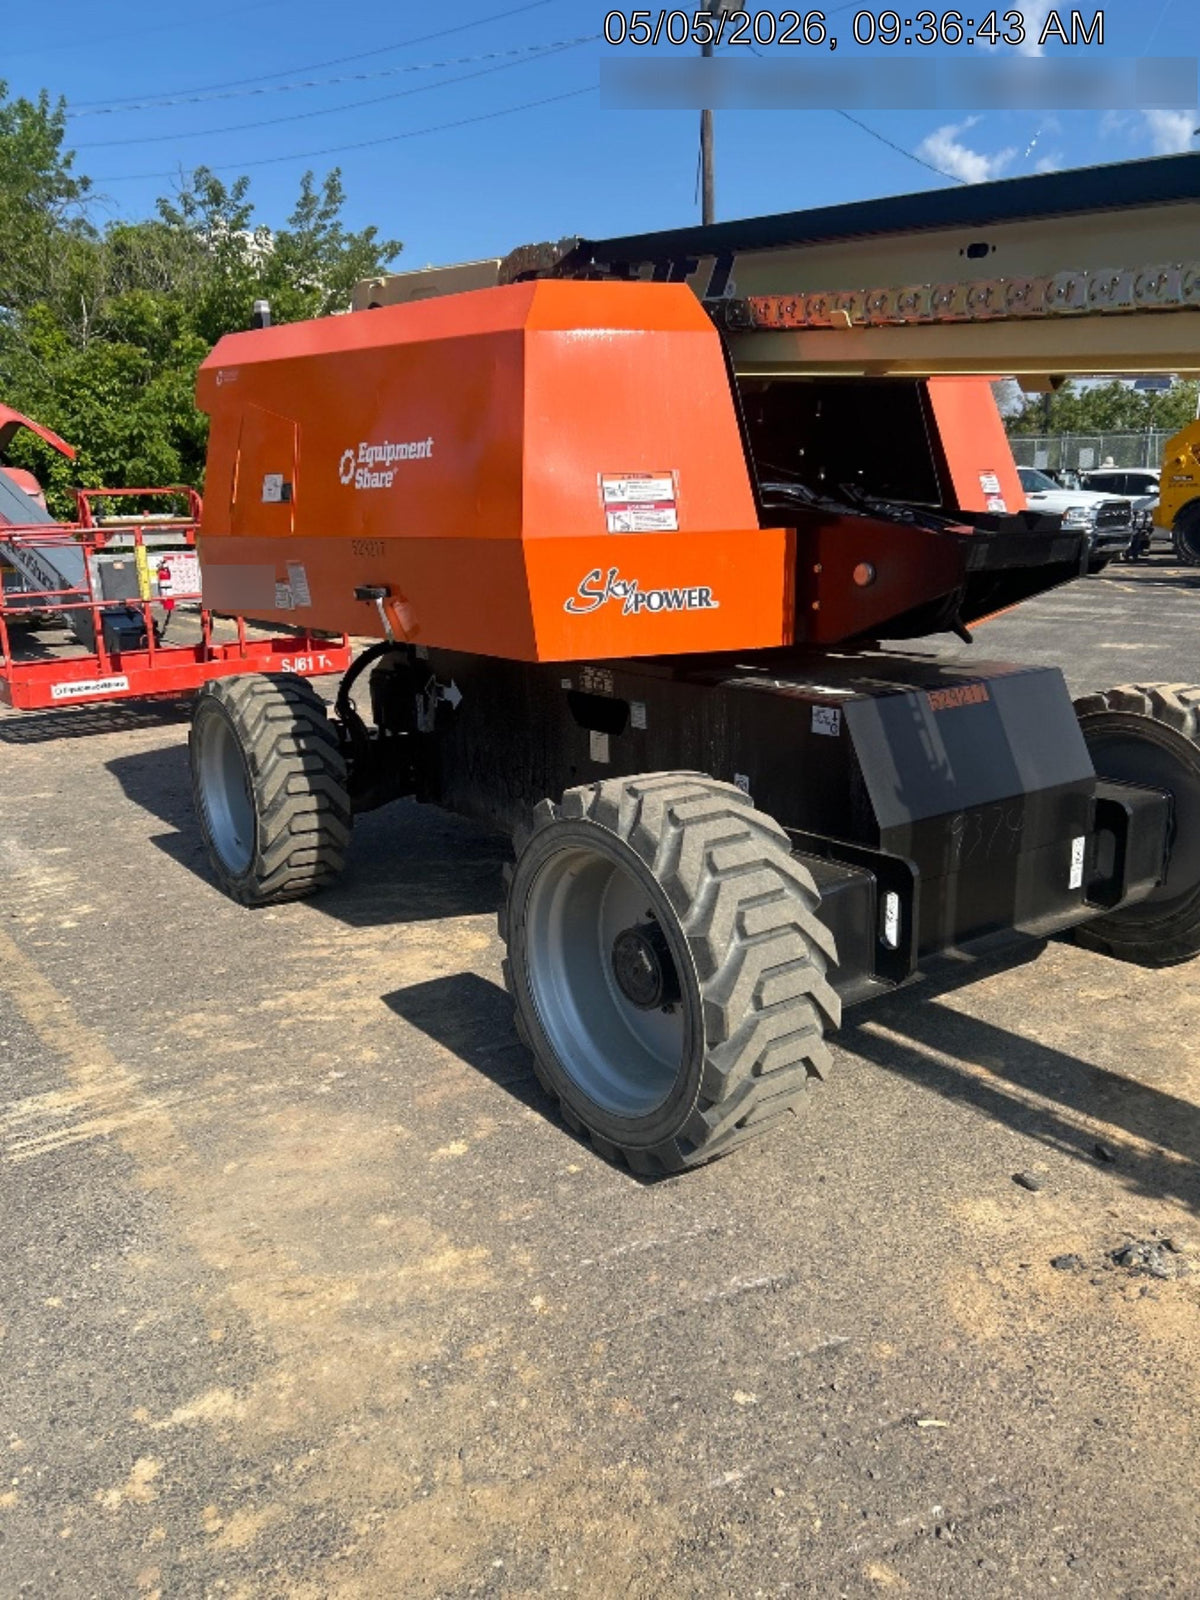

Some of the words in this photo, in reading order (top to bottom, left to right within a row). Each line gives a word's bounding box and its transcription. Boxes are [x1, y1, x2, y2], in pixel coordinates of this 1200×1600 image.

[357, 437, 434, 467] Equipment
[355, 467, 393, 489] Share
[281, 656, 314, 673] SJ61
